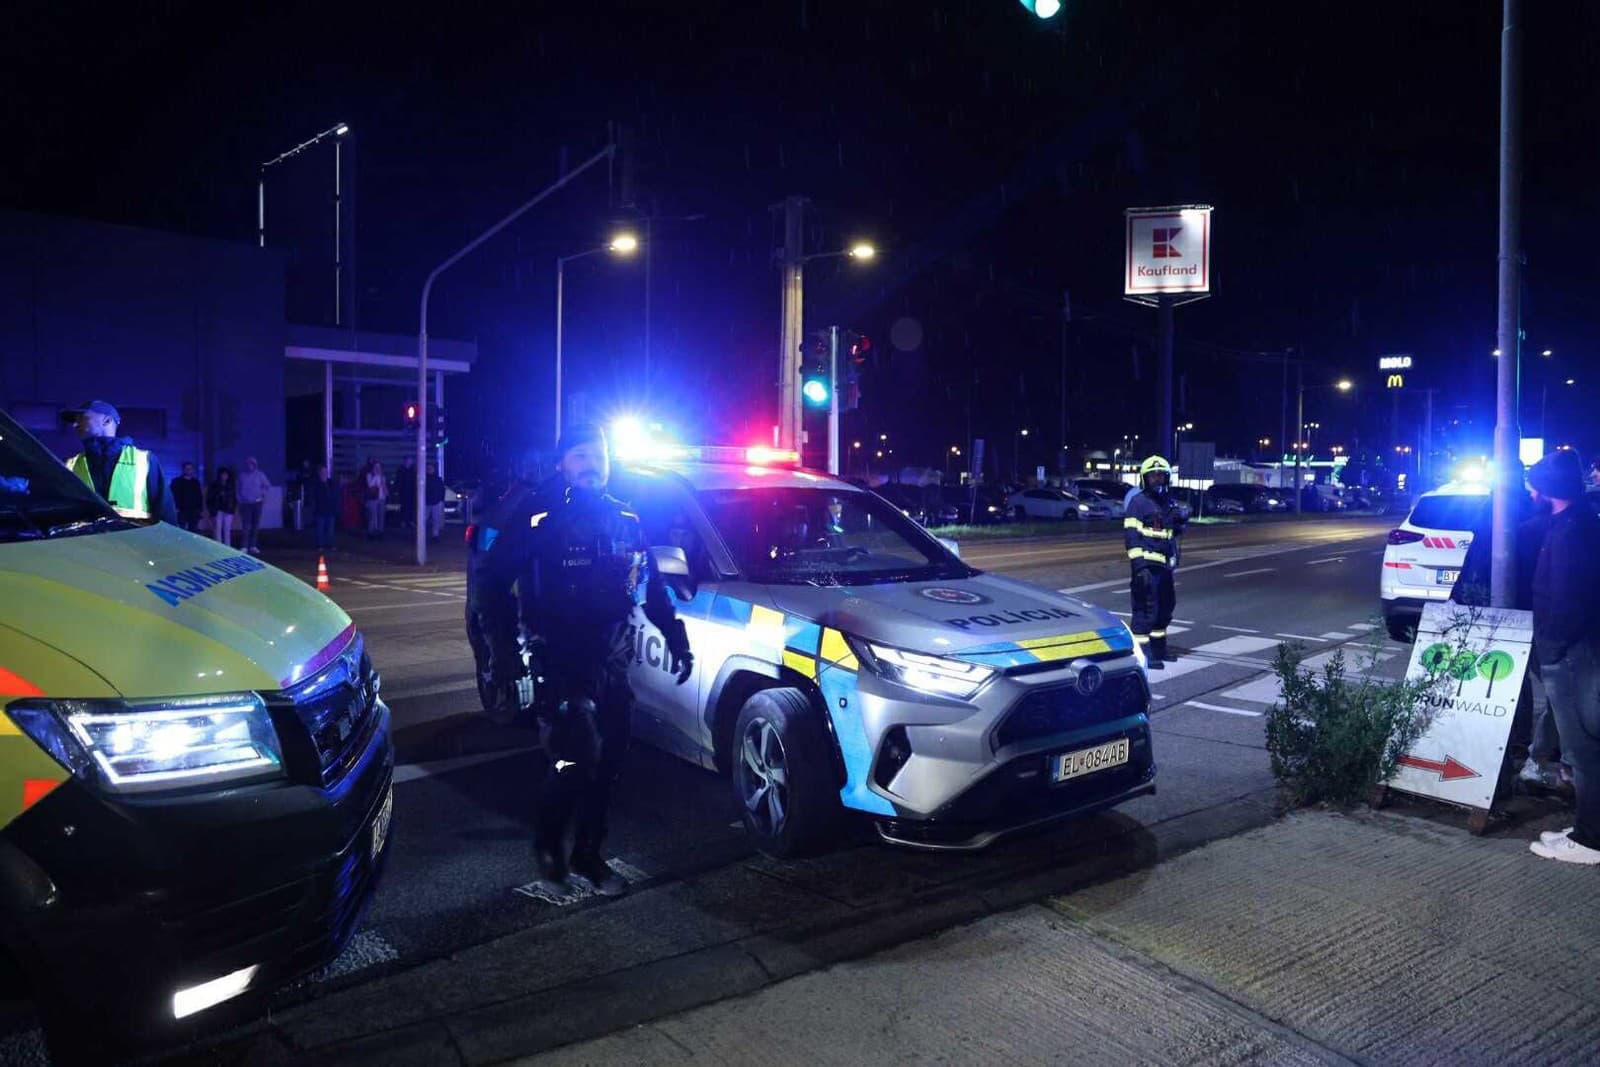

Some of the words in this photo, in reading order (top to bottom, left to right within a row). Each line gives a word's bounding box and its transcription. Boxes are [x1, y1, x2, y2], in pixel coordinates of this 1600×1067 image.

[1137, 264, 1197, 277] Kaufland
[946, 608, 1081, 630] POLÍCIA
[1064, 754, 1079, 776] EL
[1086, 743, 1125, 769] 084AB
